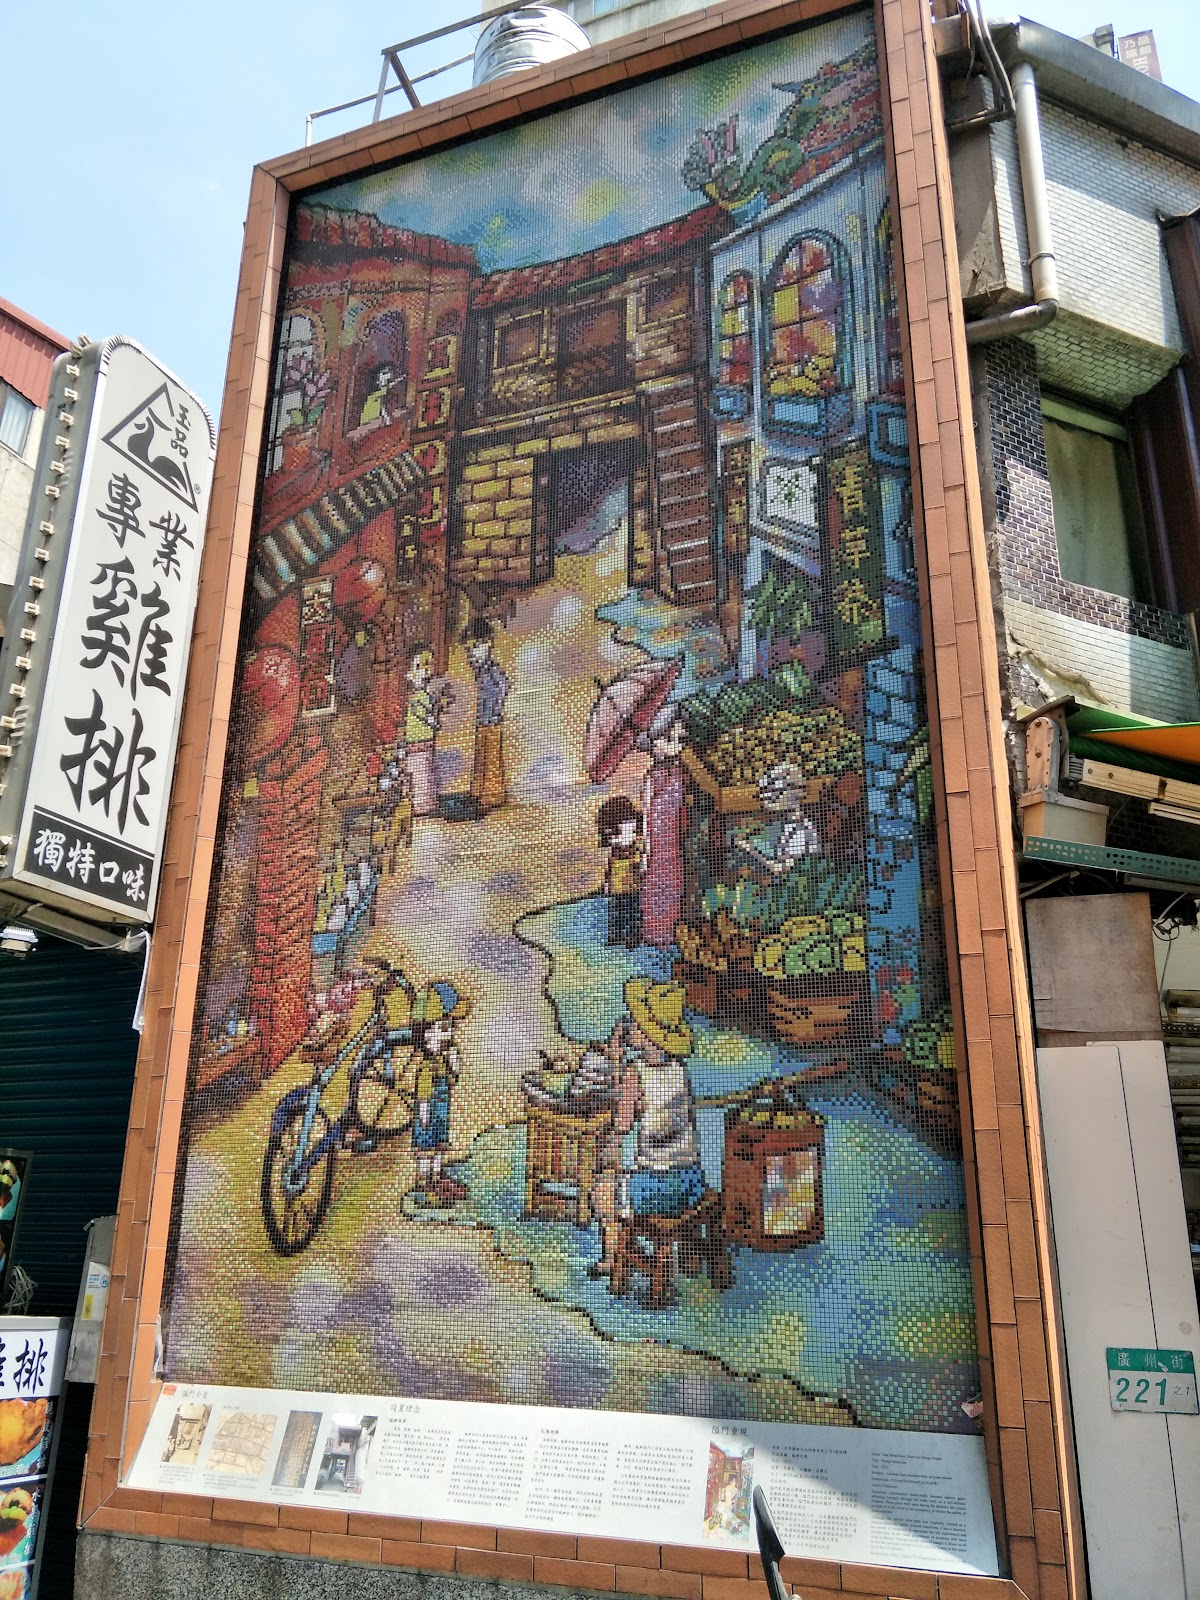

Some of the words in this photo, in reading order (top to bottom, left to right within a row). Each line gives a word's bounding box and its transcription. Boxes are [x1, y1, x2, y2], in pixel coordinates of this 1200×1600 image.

[1133, 56, 1150, 76] HO
[96, 472, 195, 581] 專業
[60, 556, 173, 836] 雞排
[33, 828, 146, 902] 獨特口味
[1117, 1352, 1184, 1370] 廣州街
[1115, 1377, 1167, 1406] 221
